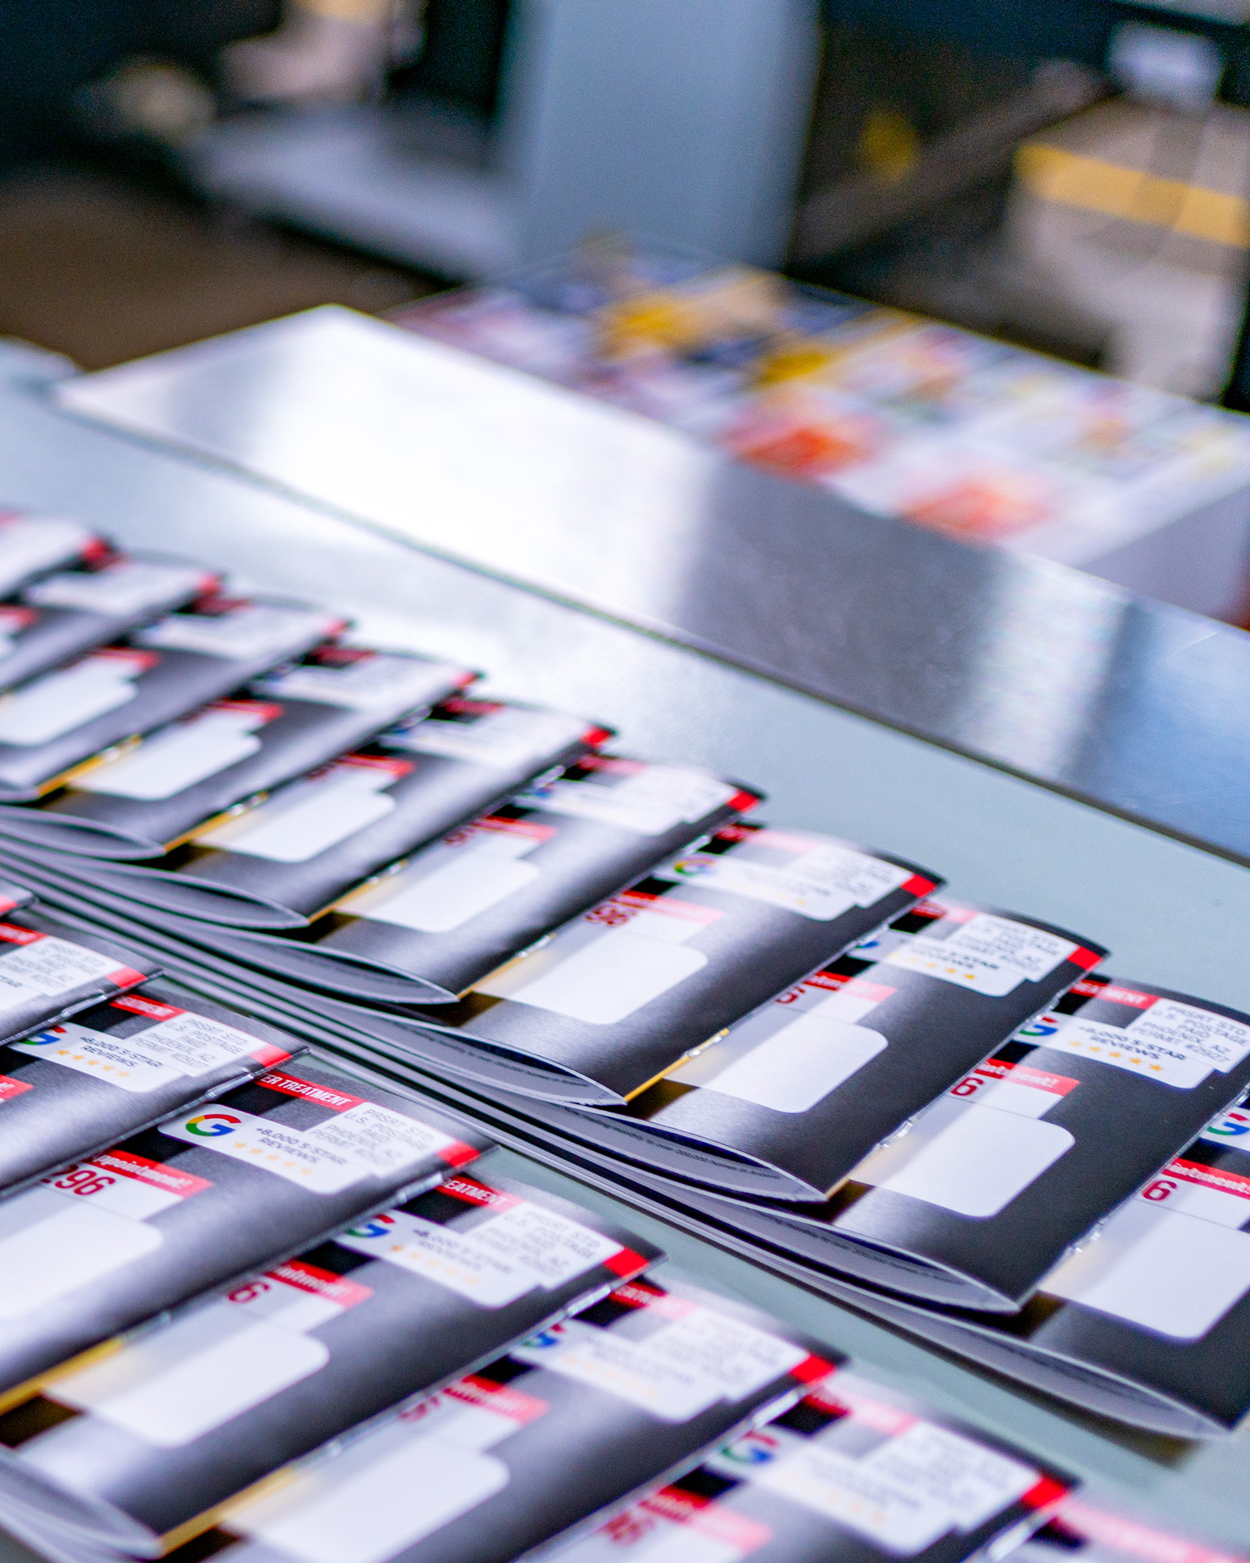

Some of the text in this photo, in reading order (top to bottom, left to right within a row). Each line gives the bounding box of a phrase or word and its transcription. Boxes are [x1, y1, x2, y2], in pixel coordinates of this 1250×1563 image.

[279, 1078, 352, 1106] TREATMENT
[185, 1113, 242, 1137] G
[257, 1137, 321, 1164] REVIEWS
[298, 1138, 348, 1166] 5-STAR
[93, 1154, 193, 1189] ppointment!
[444, 1179, 510, 1206] EATMENT
